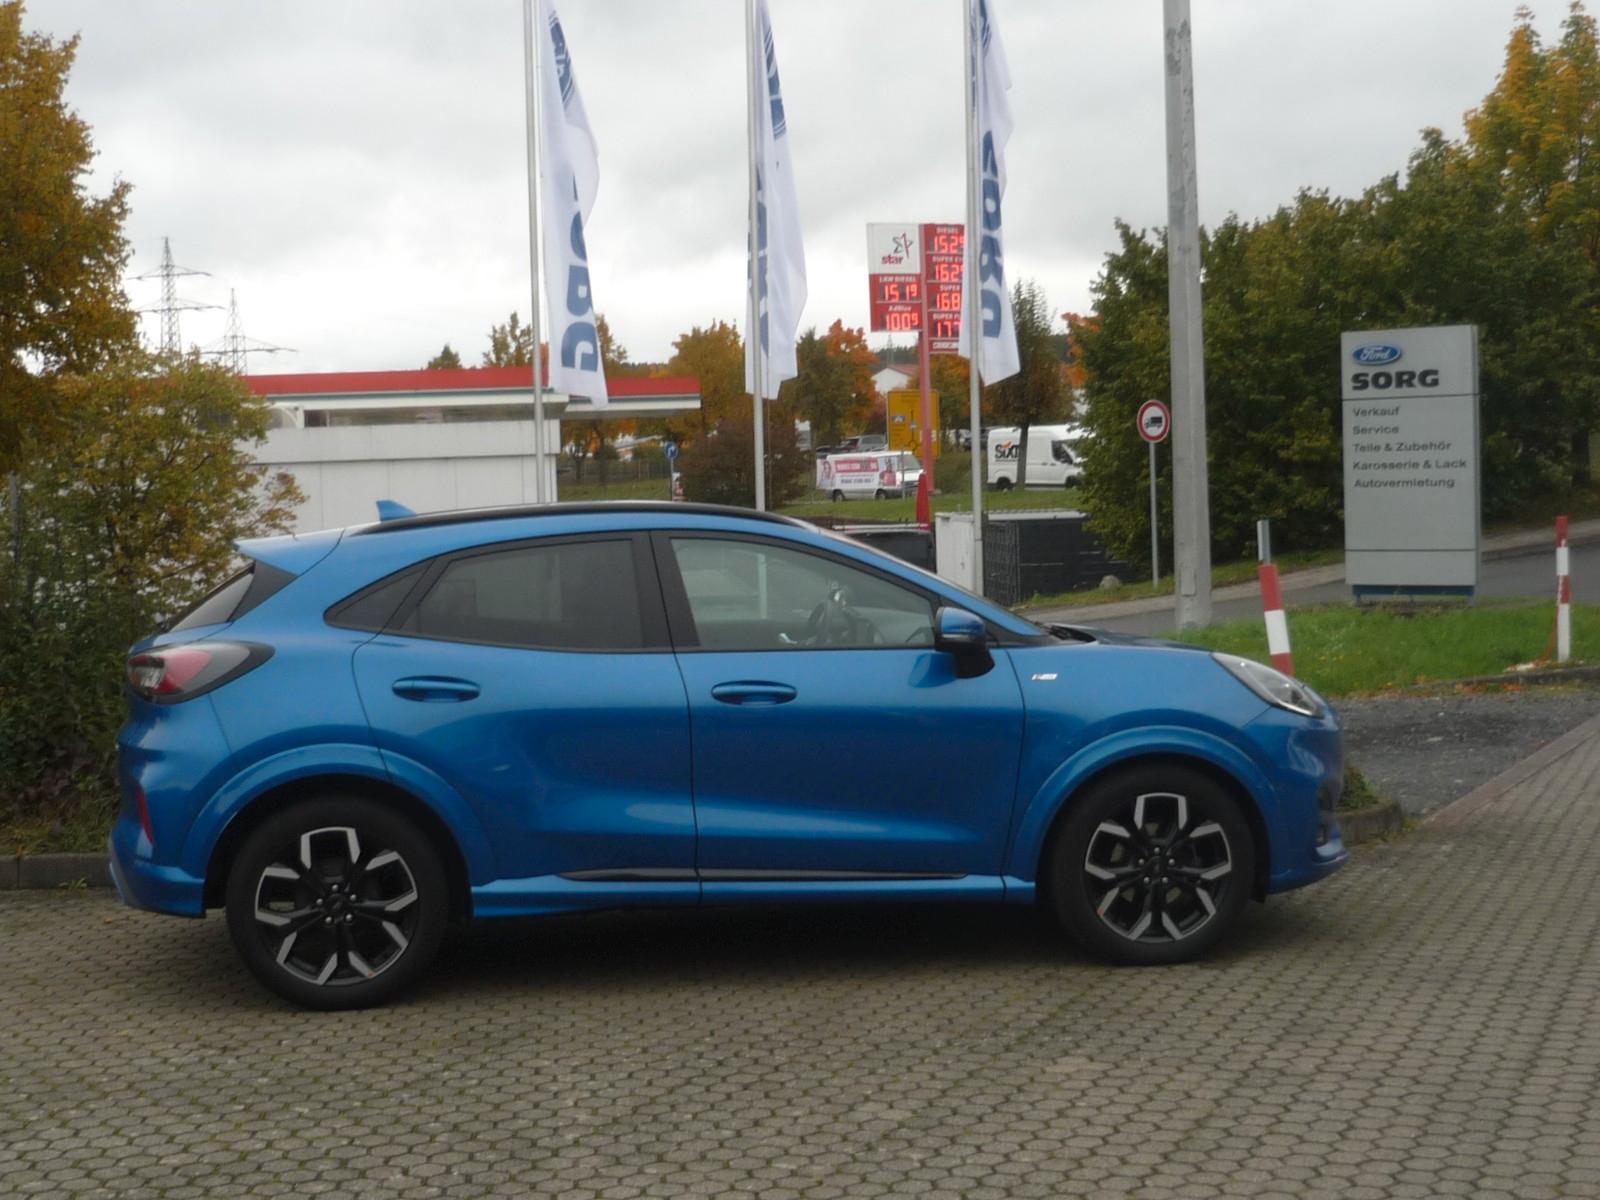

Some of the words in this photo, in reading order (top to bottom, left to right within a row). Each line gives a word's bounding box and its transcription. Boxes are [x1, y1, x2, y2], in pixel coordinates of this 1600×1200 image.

[881, 254, 904, 265] star
[886, 313, 919, 331] 1009
[1358, 345, 1391, 361] Ford
[1351, 369, 1439, 391] SORG
[1353, 407, 1400, 417] Verkauf
[1353, 425, 1399, 435] Service
[1353, 443, 1381, 453] Teile
[1384, 442, 1393, 452] &
[1396, 441, 1452, 452] Zubehör
[1353, 460, 1419, 471] Karosserie
[1422, 459, 1432, 469] &
[1435, 458, 1467, 469] Lack
[1354, 477, 1455, 489] Autovermietung
